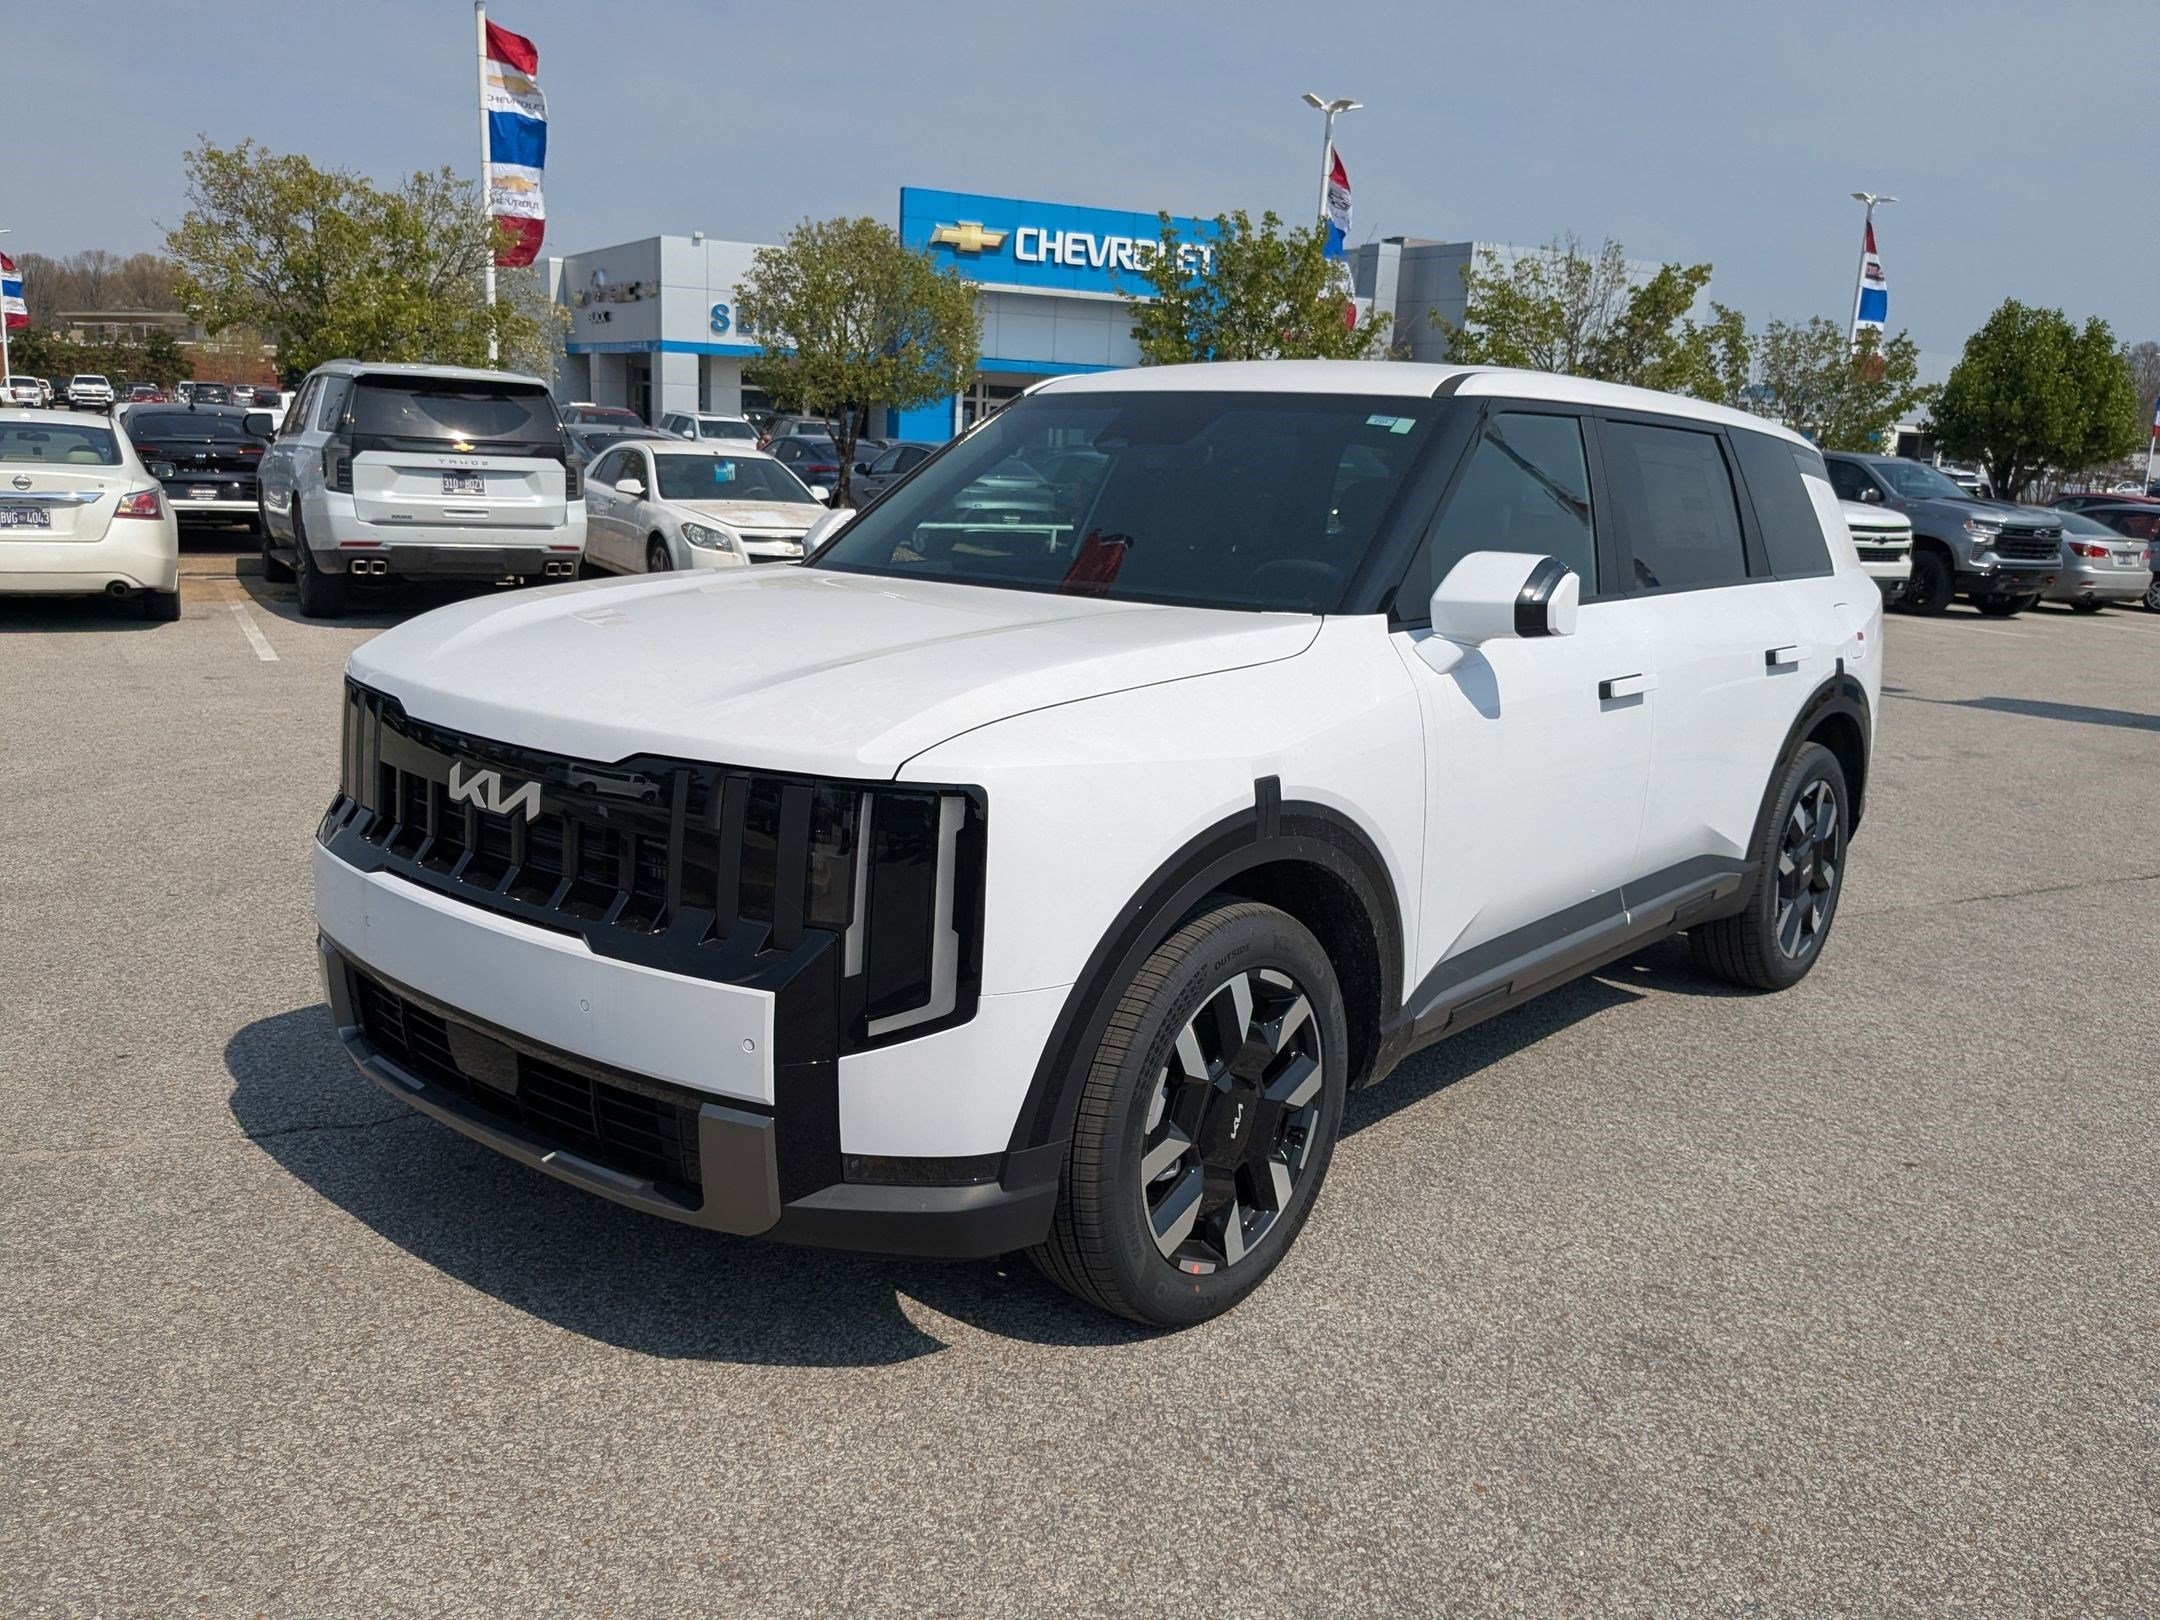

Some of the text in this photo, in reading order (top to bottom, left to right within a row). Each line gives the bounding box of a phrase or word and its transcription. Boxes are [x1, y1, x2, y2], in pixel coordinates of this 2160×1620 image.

[443, 478, 459, 489] 310
[0, 512, 50, 524] BVG 4043
